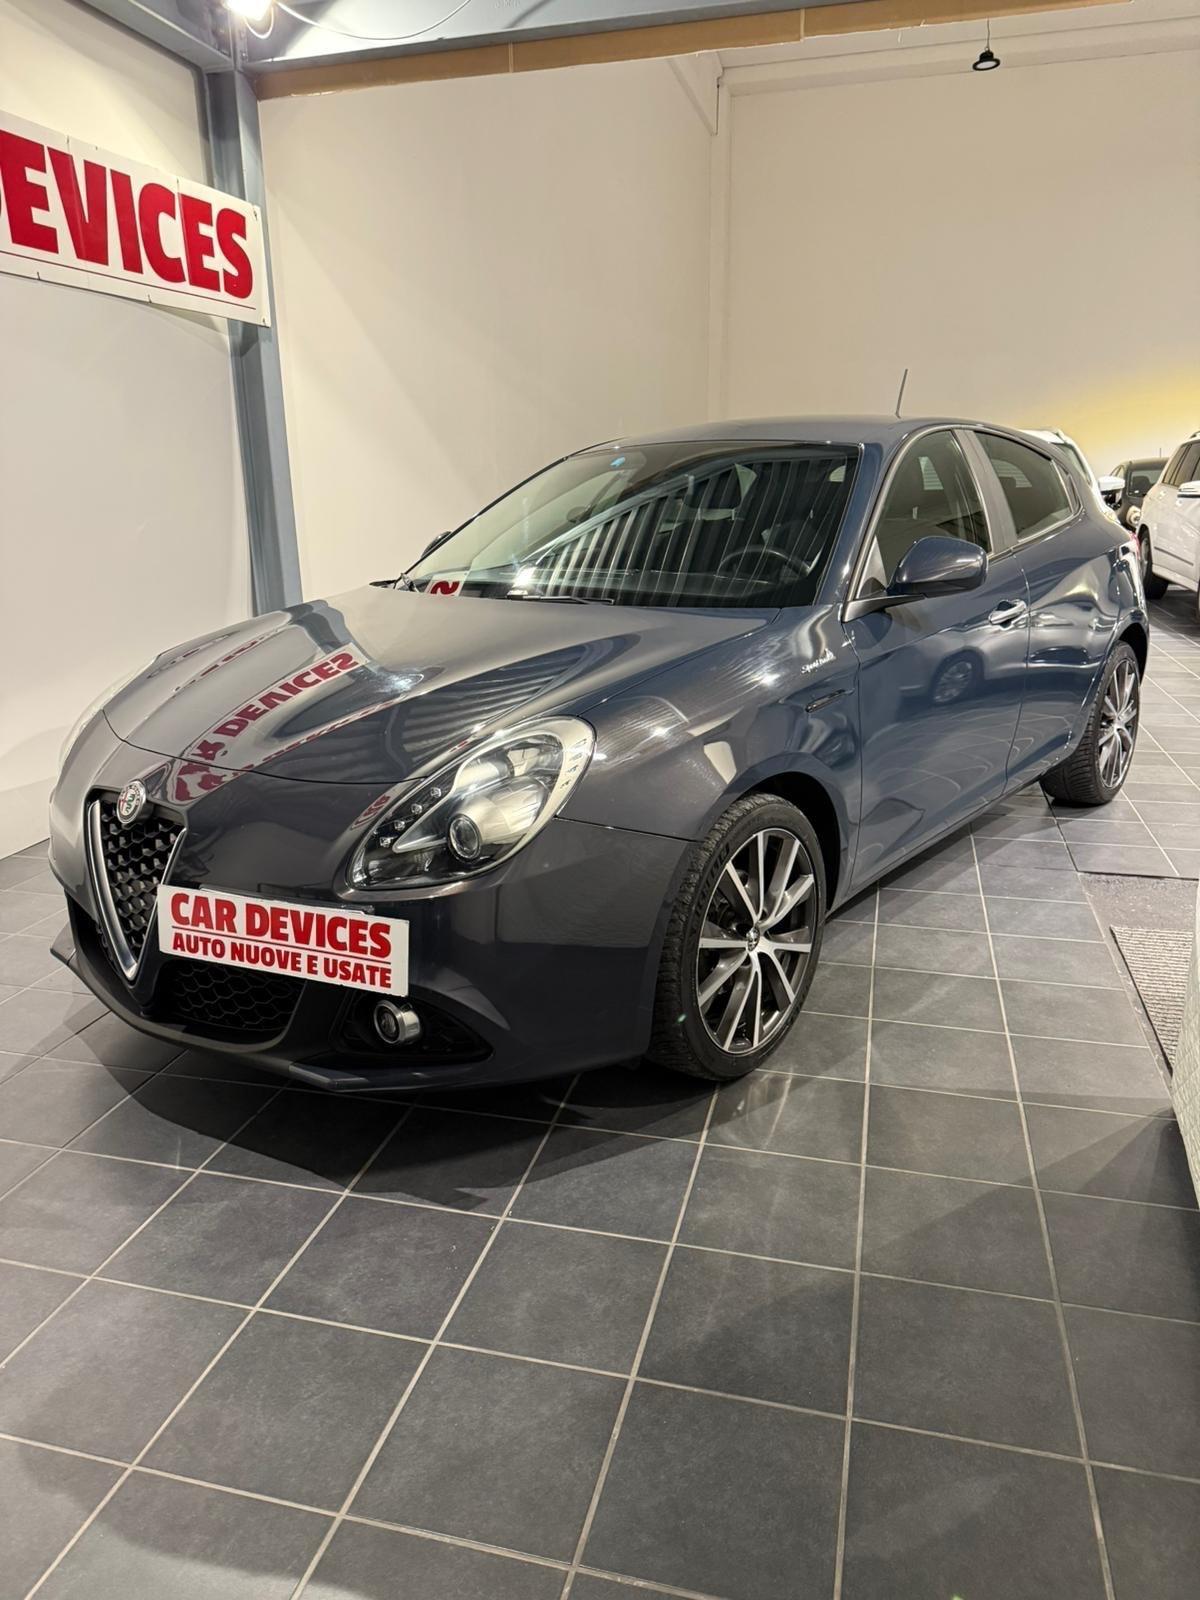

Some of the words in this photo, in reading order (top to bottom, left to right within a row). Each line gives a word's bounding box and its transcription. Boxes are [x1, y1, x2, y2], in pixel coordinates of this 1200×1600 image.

[0, 129, 254, 300] EVICES
[170, 892, 237, 935] CAR
[244, 902, 392, 960] DEVICES
[172, 932, 226, 960] AUTO
[229, 940, 302, 973] NUOVE
[306, 952, 318, 976] E
[322, 956, 392, 990] USATE
